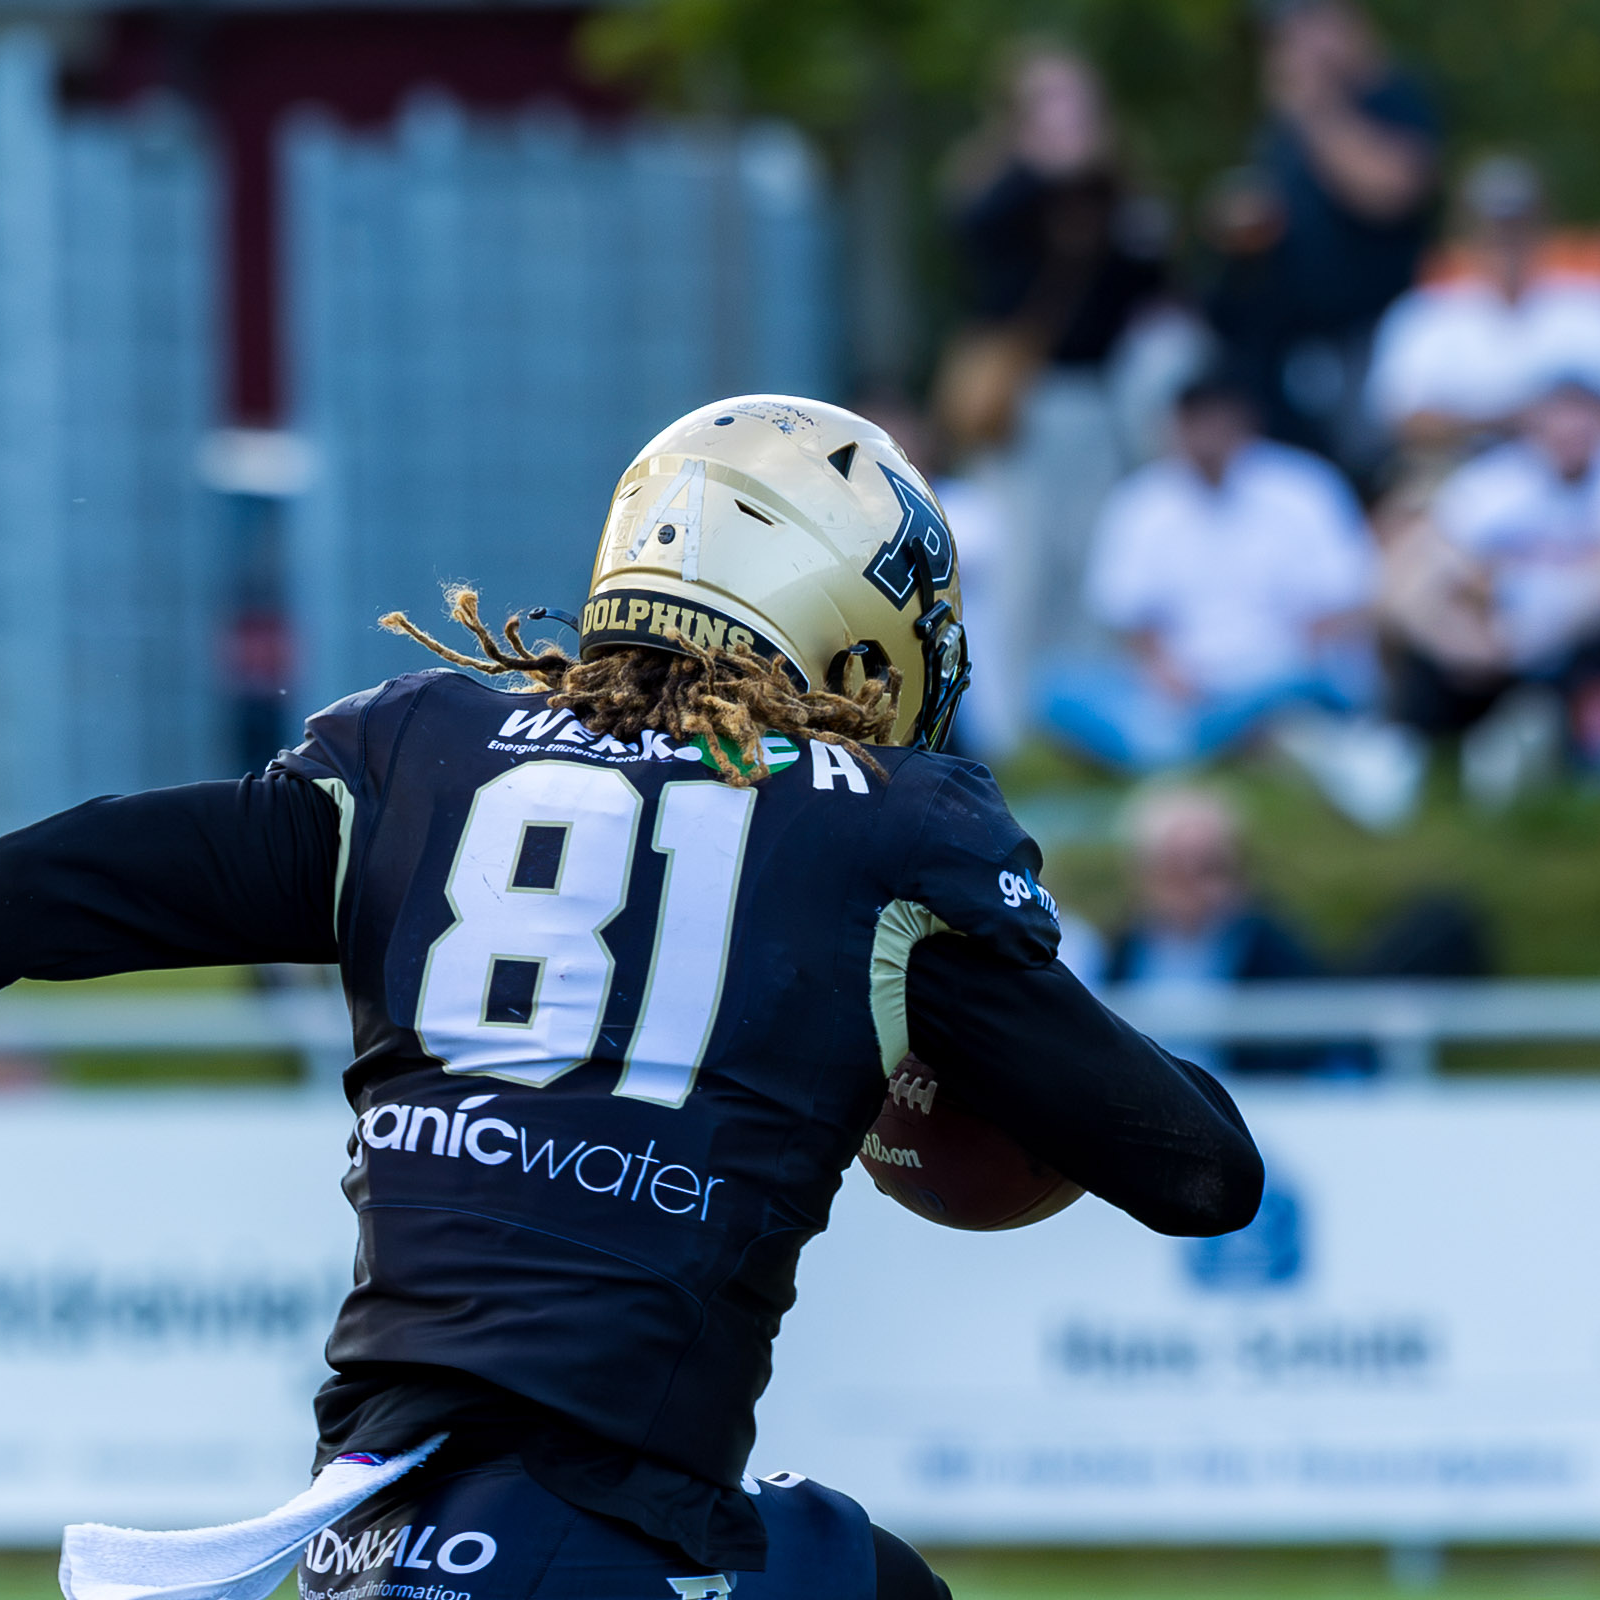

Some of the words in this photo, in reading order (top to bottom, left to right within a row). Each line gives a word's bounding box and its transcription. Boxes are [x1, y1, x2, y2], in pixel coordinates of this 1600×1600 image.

[626, 458, 706, 582] A
[582, 598, 755, 656] DOLPHINS
[810, 739, 869, 794] A
[414, 760, 758, 1109] 81
[862, 1133, 923, 1168] ilson
